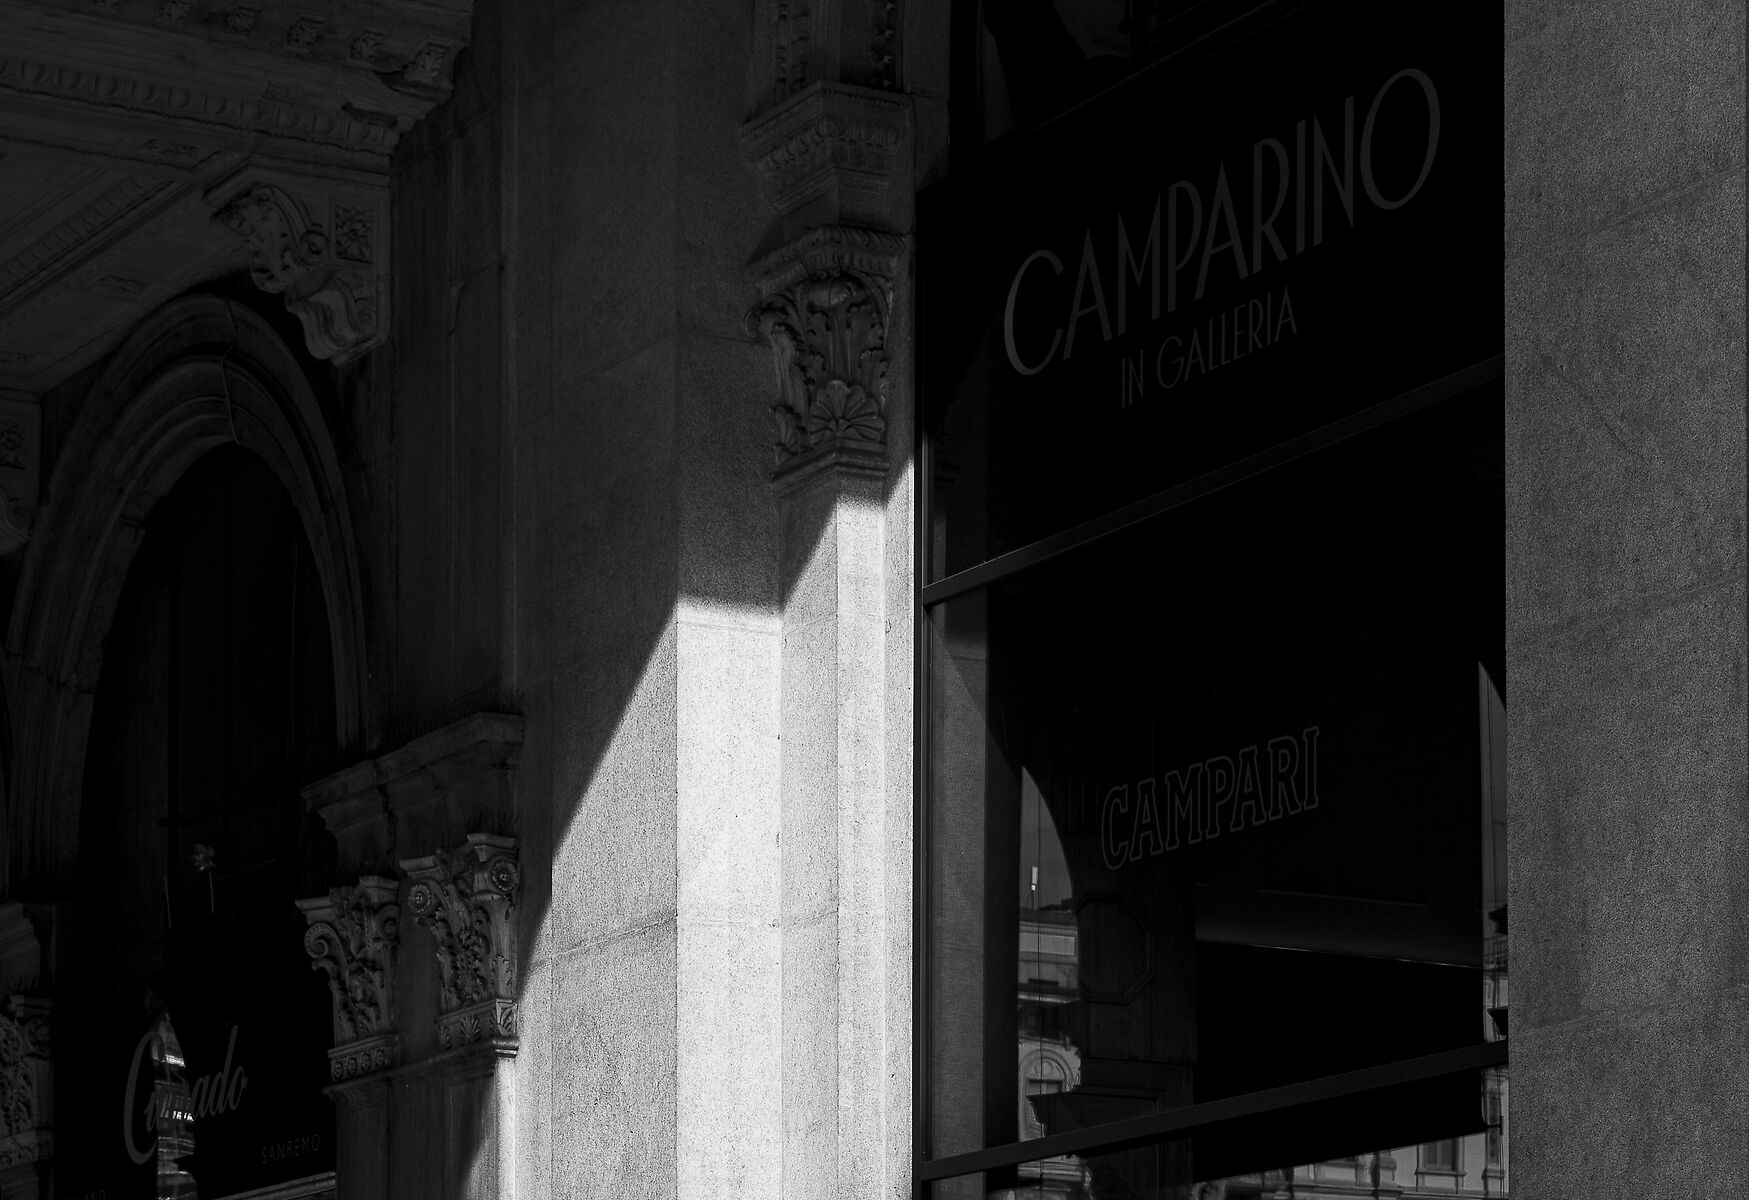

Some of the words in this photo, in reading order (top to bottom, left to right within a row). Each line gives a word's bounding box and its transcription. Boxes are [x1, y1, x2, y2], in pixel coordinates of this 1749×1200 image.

[1004, 67, 1441, 376] CAMPARINO
[1121, 348, 1144, 409] IN
[1156, 284, 1298, 389] GALLERIA
[1102, 725, 1320, 871] CAMPARI
[123, 1024, 248, 1165] Cuado
[261, 1134, 320, 1165] SANREMO
